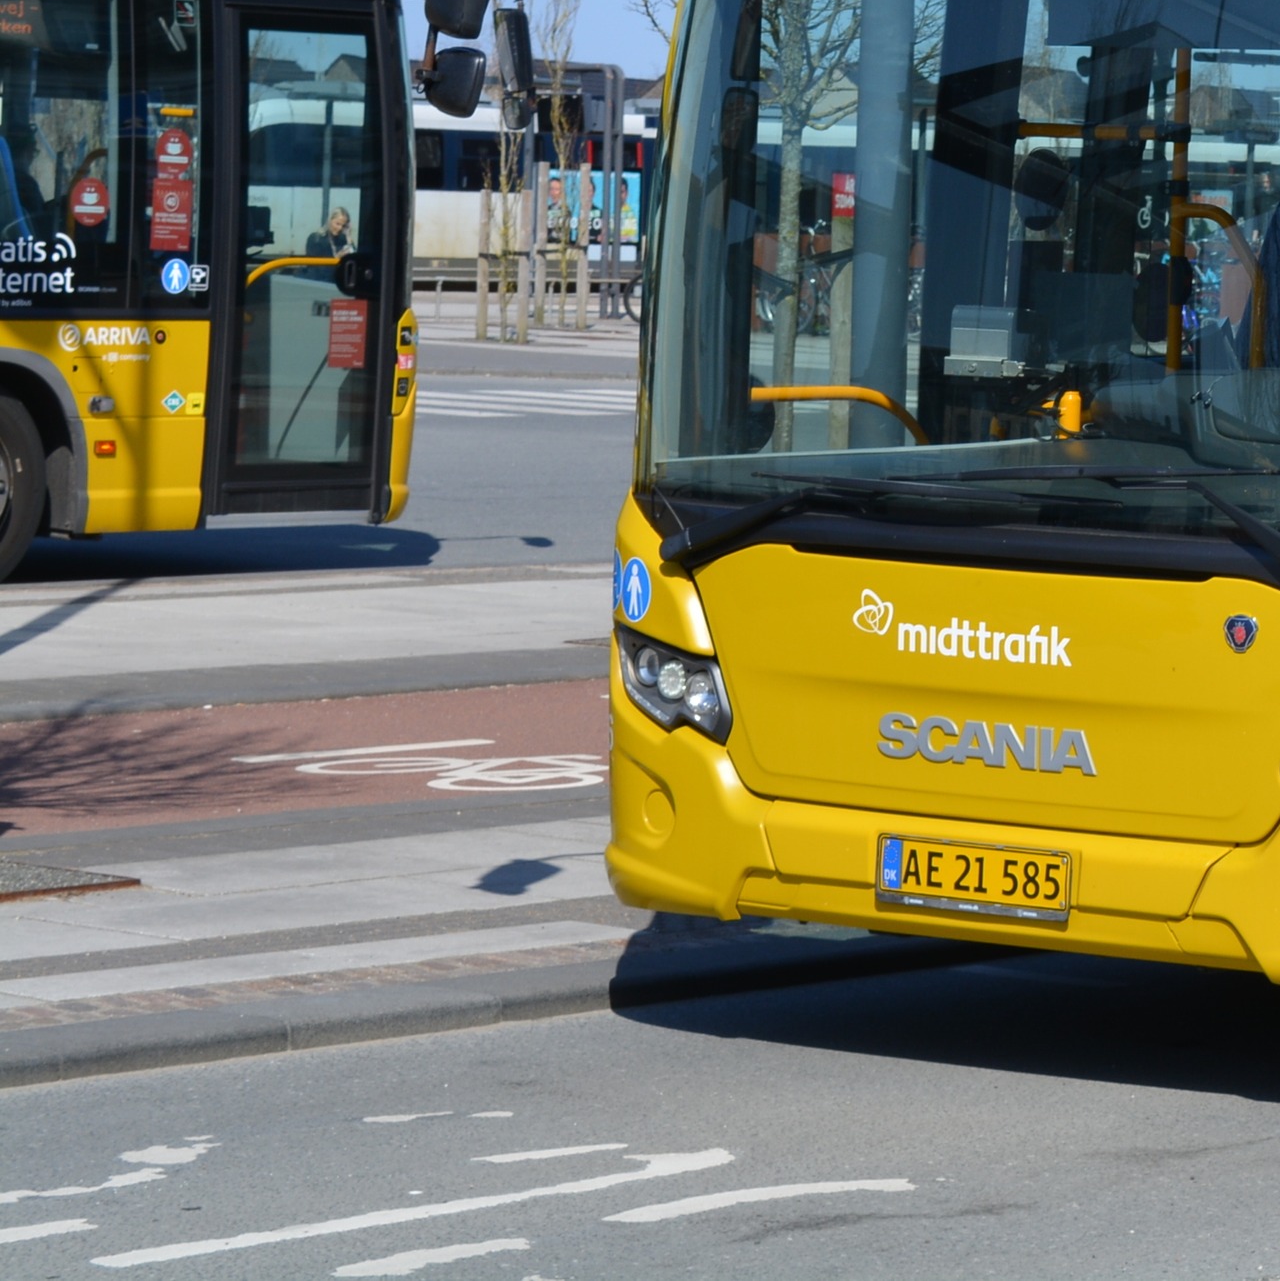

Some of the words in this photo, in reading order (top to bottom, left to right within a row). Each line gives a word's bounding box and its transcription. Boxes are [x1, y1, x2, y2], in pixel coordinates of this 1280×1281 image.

[82, 326, 151, 346] ARRIVA
[897, 616, 1073, 668] midttrafik
[876, 711, 1098, 777] SCANIA
[883, 868, 897, 882] DK
[903, 849, 943, 889] AE
[953, 854, 988, 894] 21
[1001, 859, 1061, 901] 585
